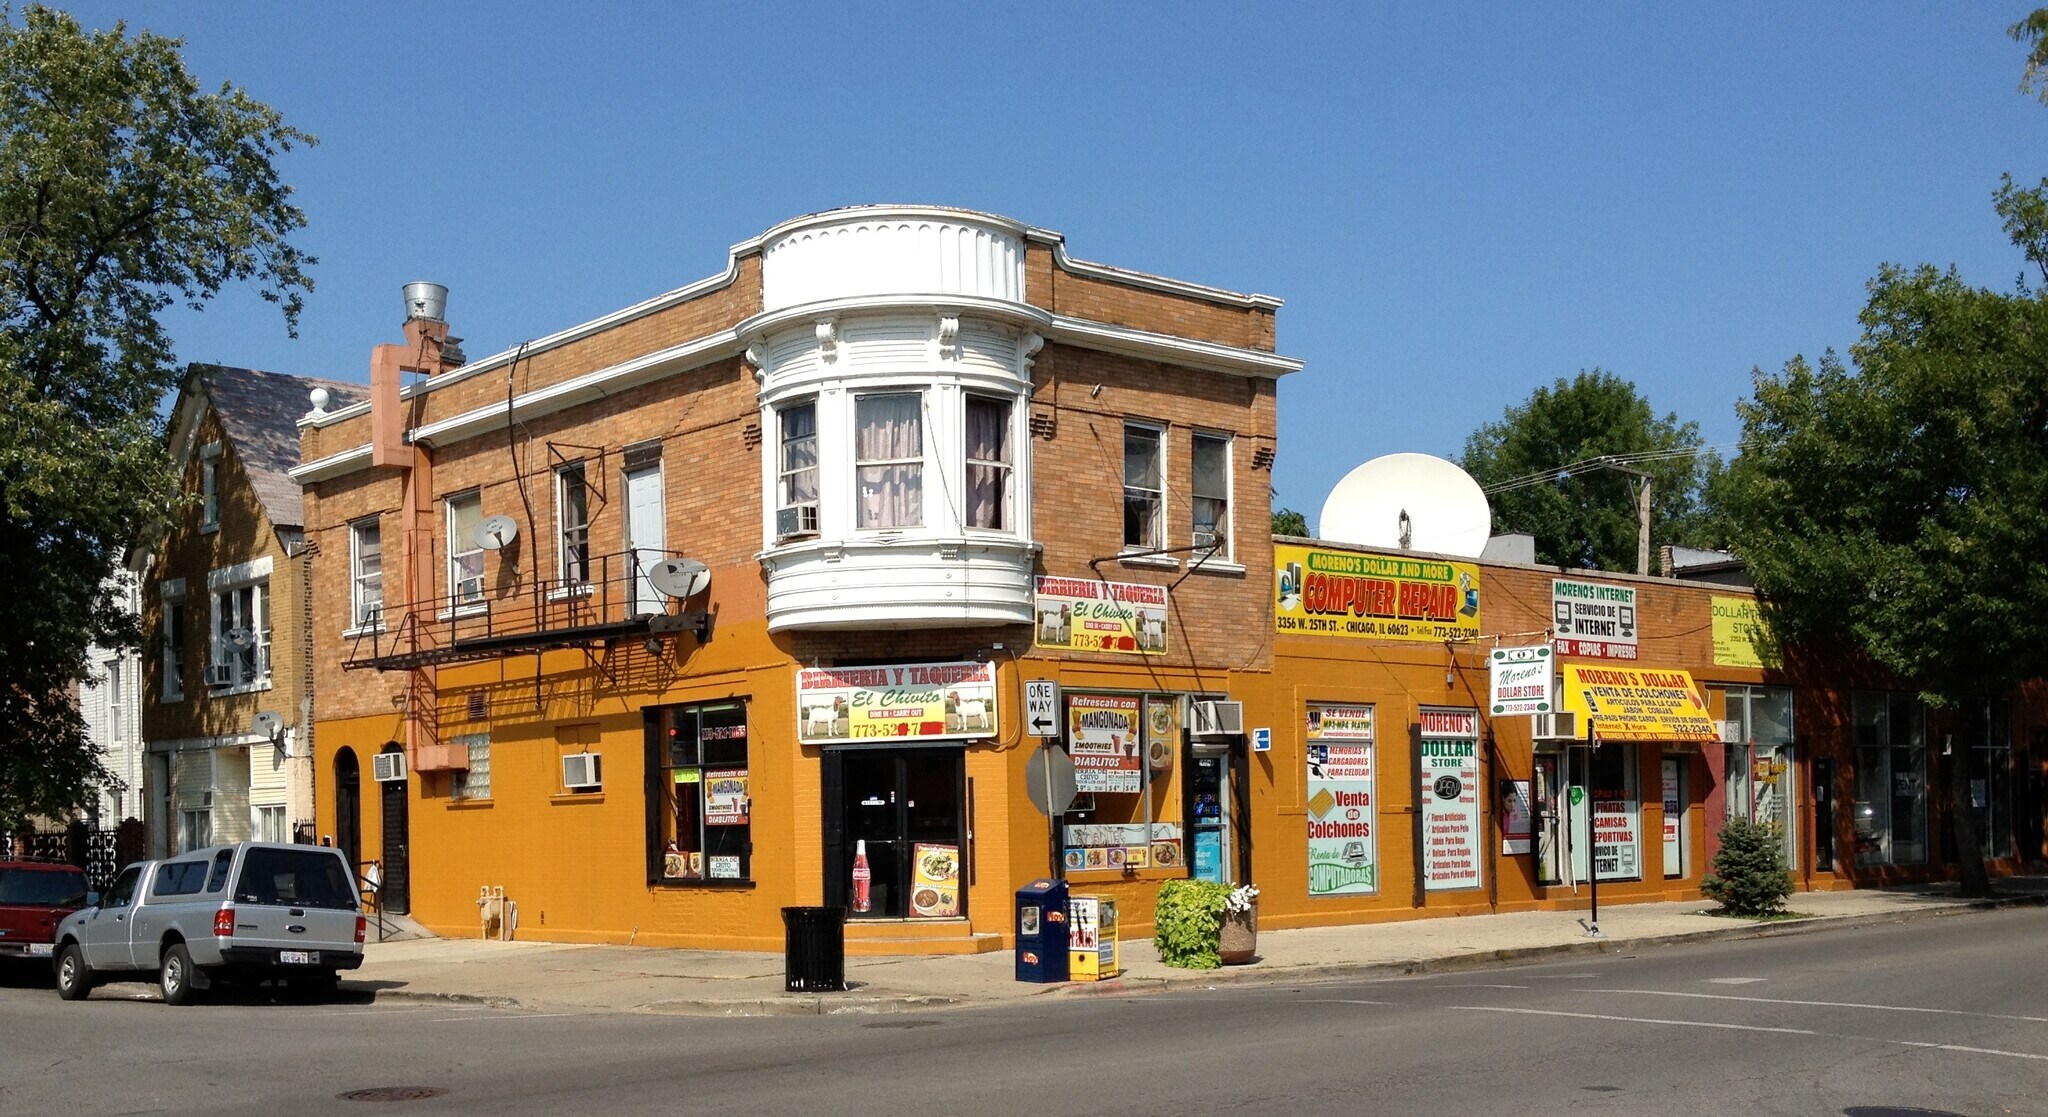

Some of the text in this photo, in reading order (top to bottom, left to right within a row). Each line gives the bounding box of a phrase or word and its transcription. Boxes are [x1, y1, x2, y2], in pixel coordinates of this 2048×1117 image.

[1312, 554, 1449, 580] MORENO'S DOLLAR AND MORE
[1037, 577, 1166, 604] BIRRIERIA Y TAQUERIA
[1303, 572, 1458, 622] COMPUTER REPAIR
[1555, 582, 1634, 603] MORENO'S INTERNET
[1073, 601, 1134, 620] El Chivito
[1575, 603, 1615, 617] SERVICIO DE
[1712, 605, 1749, 619] DOLLAR
[1113, 623, 1121, 631] OUT
[1277, 617, 1296, 630] 3356
[1298, 618, 1307, 630] W.
[1309, 619, 1327, 632] 25TH
[1329, 620, 1339, 632] ST.
[1346, 621, 1377, 635] CHICAGO,
[1379, 624, 1385, 635] IL
[1387, 624, 1409, 636] 60623
[1434, 626, 1479, 639] 773-522-2340
[1575, 618, 1616, 637] INTERNET
[1556, 640, 1637, 659] FAX COPIAS IMPRESOS
[800, 664, 990, 690] BIRRIERIA Y TAQUERIA
[1499, 665, 1543, 686] Moreno's
[1576, 669, 1689, 688] MORENO'S DOLLAR
[1030, 686, 1050, 698] ONE
[1498, 685, 1544, 698] DOLLAR STORE
[1591, 686, 1688, 700] VENTA DE COLCHONES
[852, 690, 942, 708] El Chivito
[1072, 697, 1118, 708] Refrescate
[893, 709, 910, 717] CARRY
[1029, 701, 1052, 712] WAY
[1326, 709, 1366, 718] SE VENDE
[1505, 703, 1536, 711] 773-522-2340
[1082, 711, 1128, 729] MANGONADA
[1420, 712, 1472, 733] MORENO'S
[1624, 722, 1630, 731] X
[1673, 724, 1712, 734] 522-2340
[1074, 742, 1112, 750] SMOOTHIES
[1421, 740, 1473, 757] DOLLAR
[1074, 757, 1120, 767] DIABLITOS
[1431, 758, 1463, 767] STORE
[1434, 780, 1460, 795] OPEN
[1335, 791, 1369, 806] Venta
[1347, 810, 1359, 818] de
[1308, 821, 1369, 838] Colchones
[1595, 817, 1627, 828] CAMISAS
[1594, 831, 1633, 842] EPORTIVAS
[1447, 849, 1456, 857] Para
[1612, 846, 1618, 855] DE
[1451, 860, 1460, 868] Para
[1596, 858, 1618, 873] TERNET
[1308, 864, 1372, 891] COMPUTADORAS
[1047, 911, 1065, 923] Hoy
[1069, 928, 1097, 949] ratis!
[1023, 951, 1039, 965] Hoy
